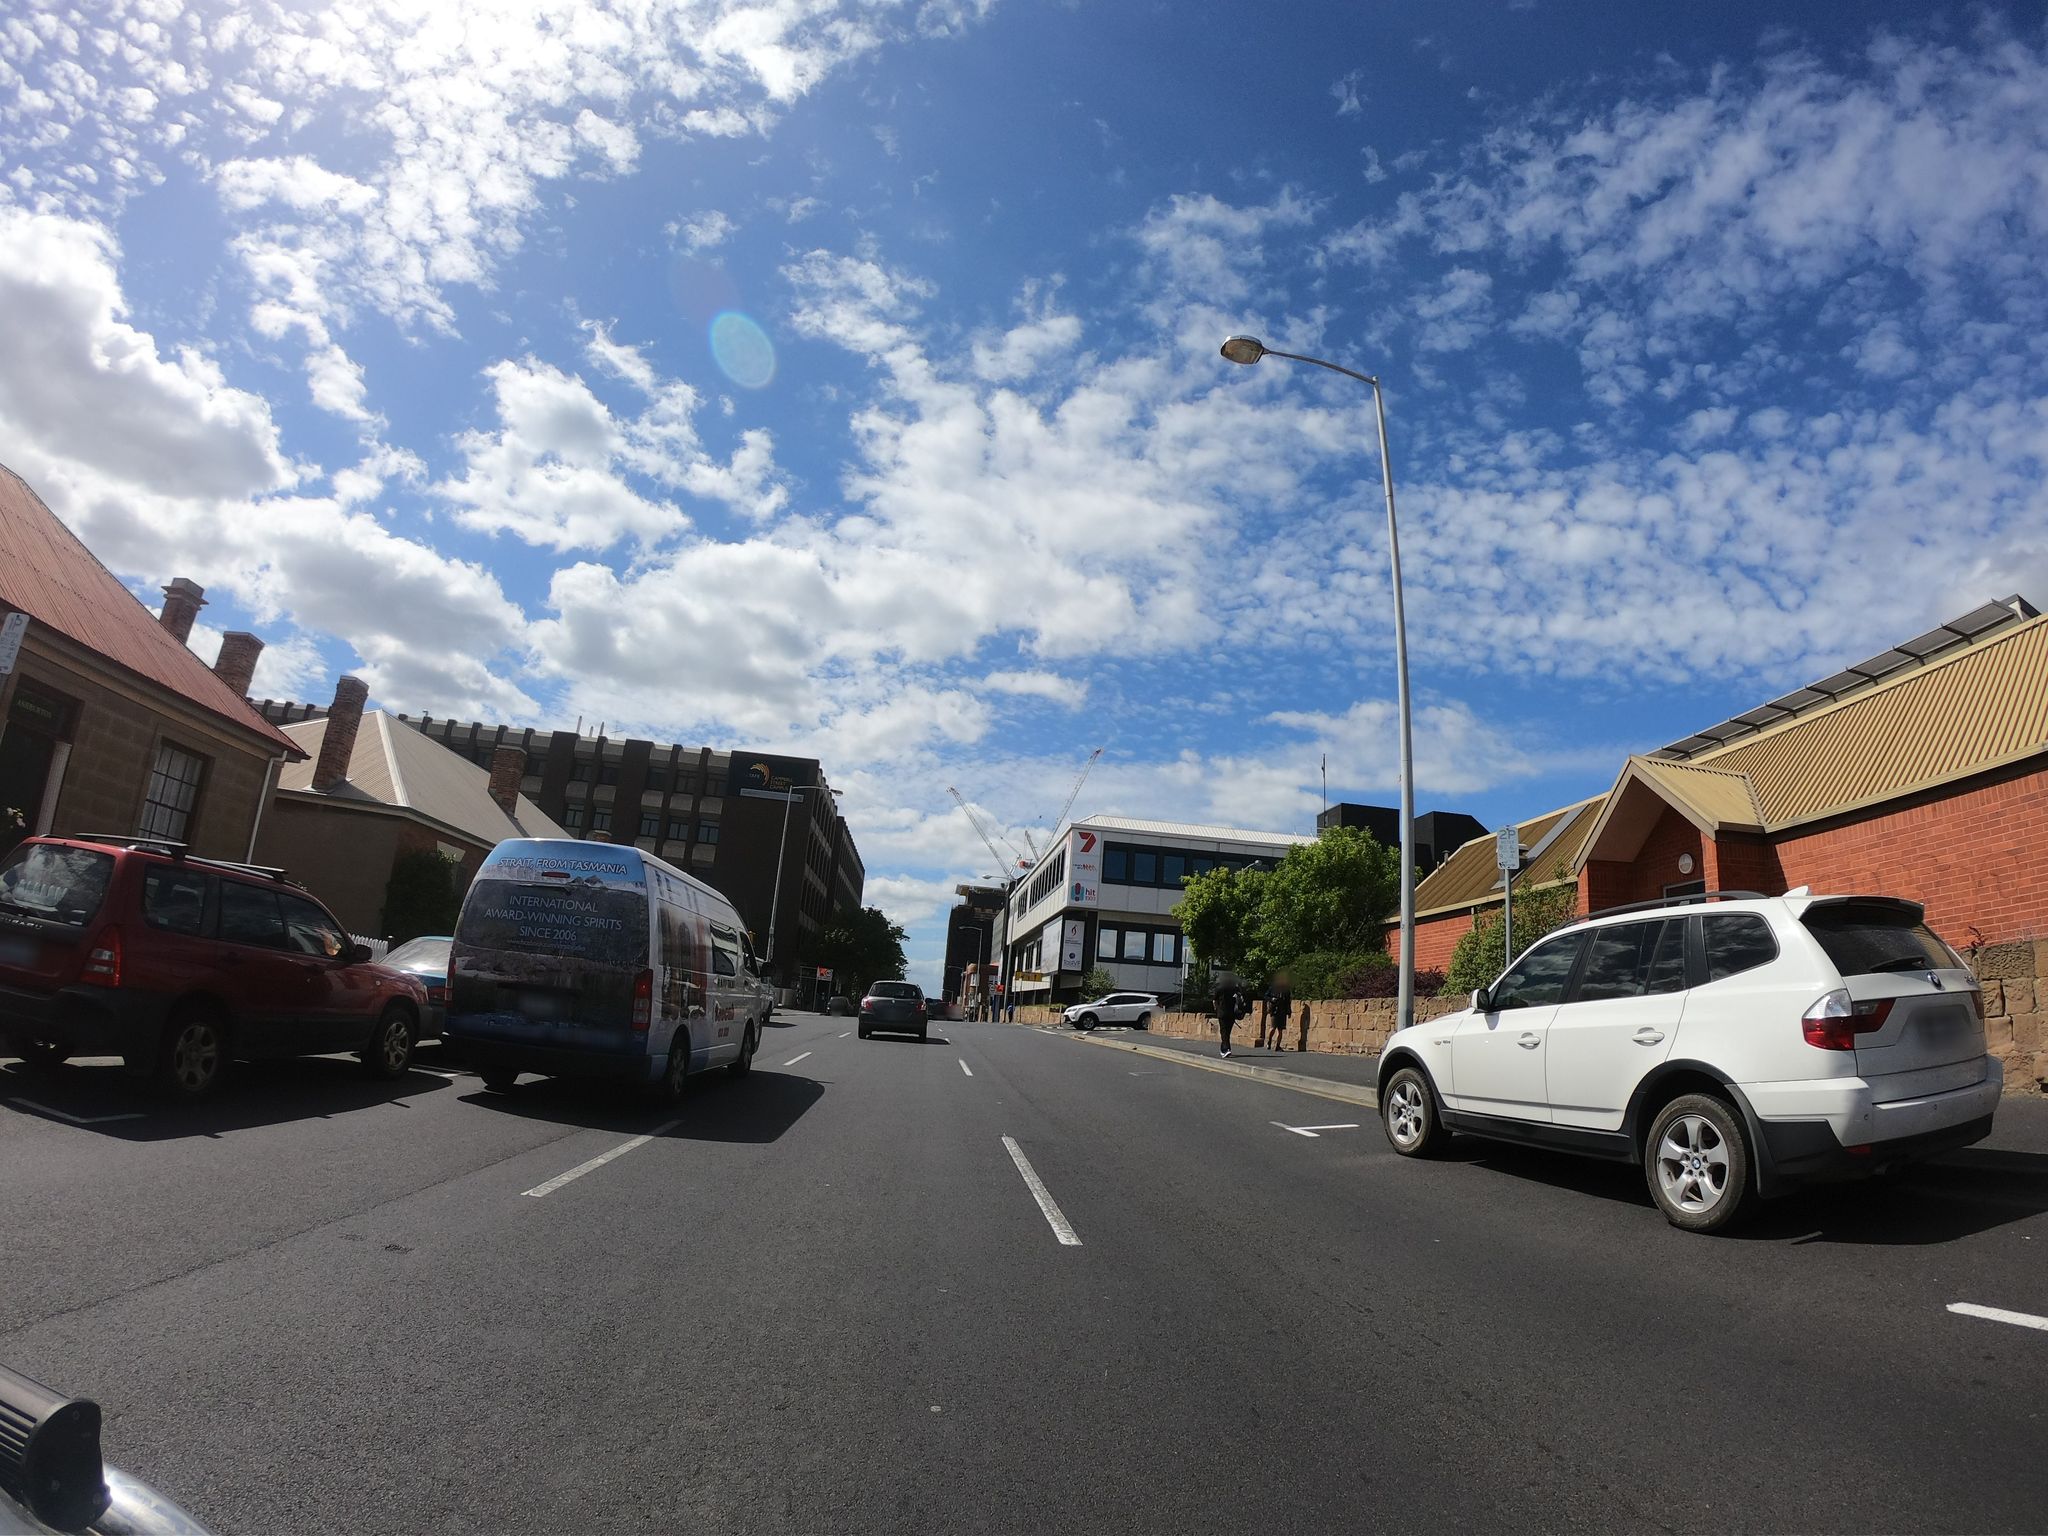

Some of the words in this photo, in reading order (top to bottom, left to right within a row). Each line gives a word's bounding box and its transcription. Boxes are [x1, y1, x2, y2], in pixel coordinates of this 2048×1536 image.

[1078, 832, 1097, 853] 7
[1499, 830, 1516, 839] 2P
[498, 857, 534, 868] STRAIT,
[537, 858, 567, 869] FROM
[569, 860, 627, 874] TASMANIA
[1085, 888, 1096, 896] hit
[509, 895, 598, 913] INTERNATIONAL
[484, 907, 581, 925] AWARD-WINNING
[583, 917, 622, 931] SPIRITS
[519, 926, 552, 939] SINCE
[553, 928, 577, 941] 2006
